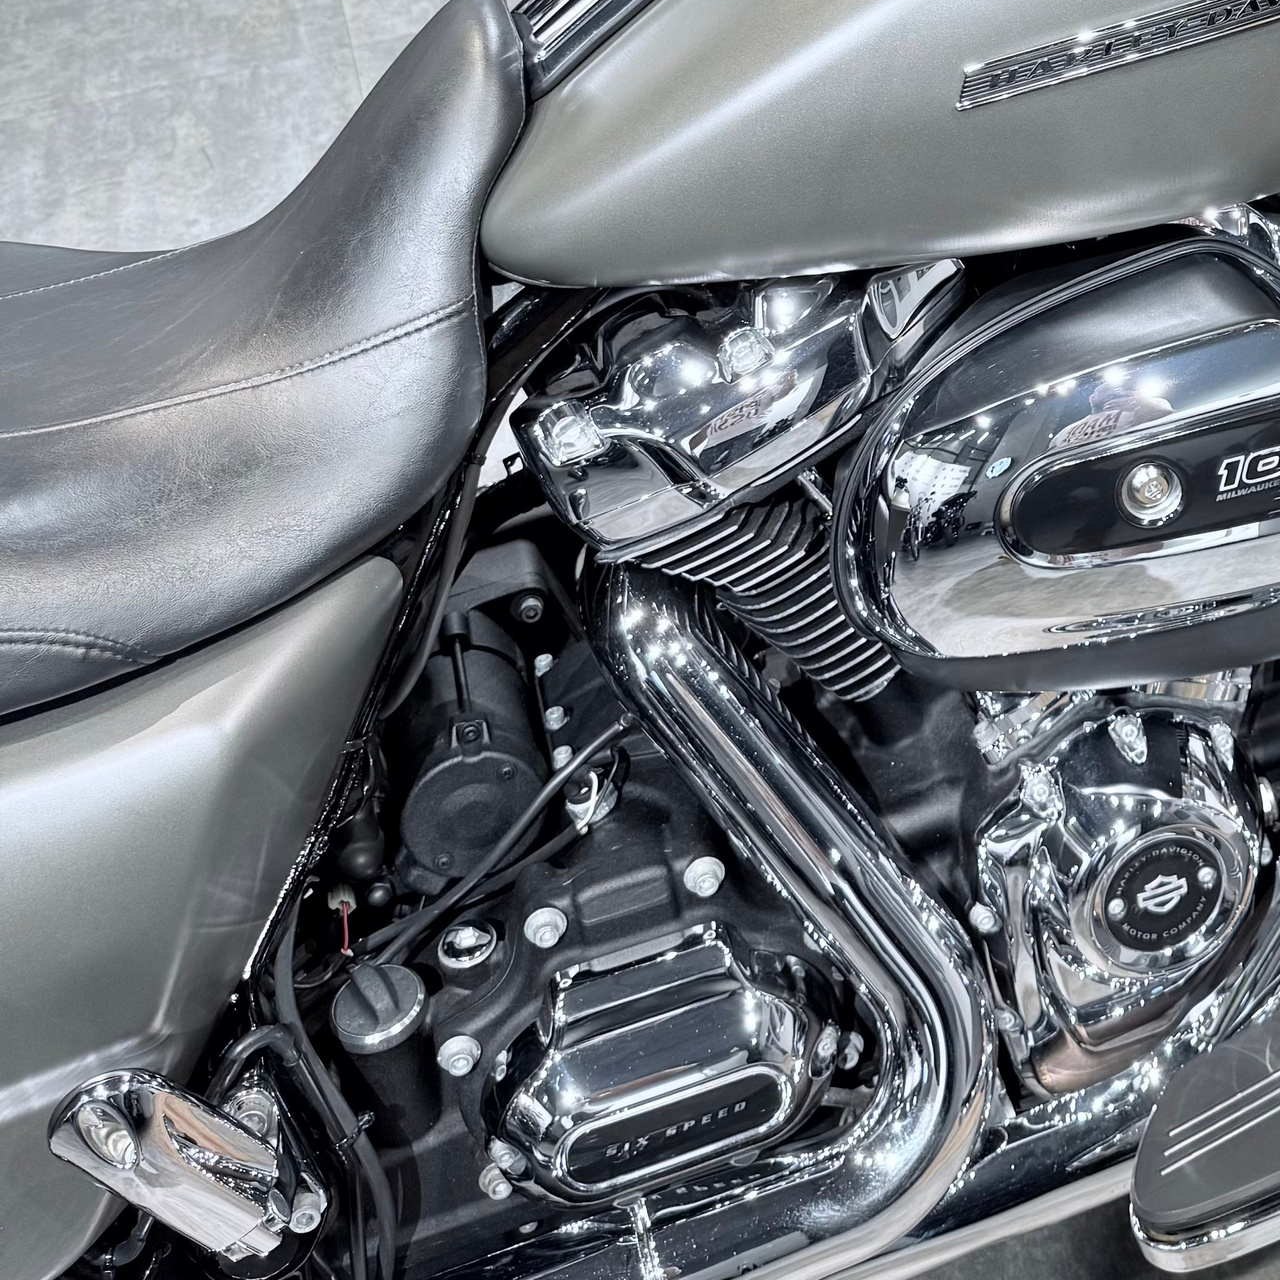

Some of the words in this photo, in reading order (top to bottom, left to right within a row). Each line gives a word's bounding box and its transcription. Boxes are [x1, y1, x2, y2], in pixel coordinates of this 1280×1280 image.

[1116, 846, 1205, 895] HARLEY-DAVIDSON
[1121, 922, 1158, 940] MOTOR
[1163, 895, 1208, 938] COMPANY
[605, 1135, 650, 1157] SIX
[665, 1101, 746, 1137] SPEED
